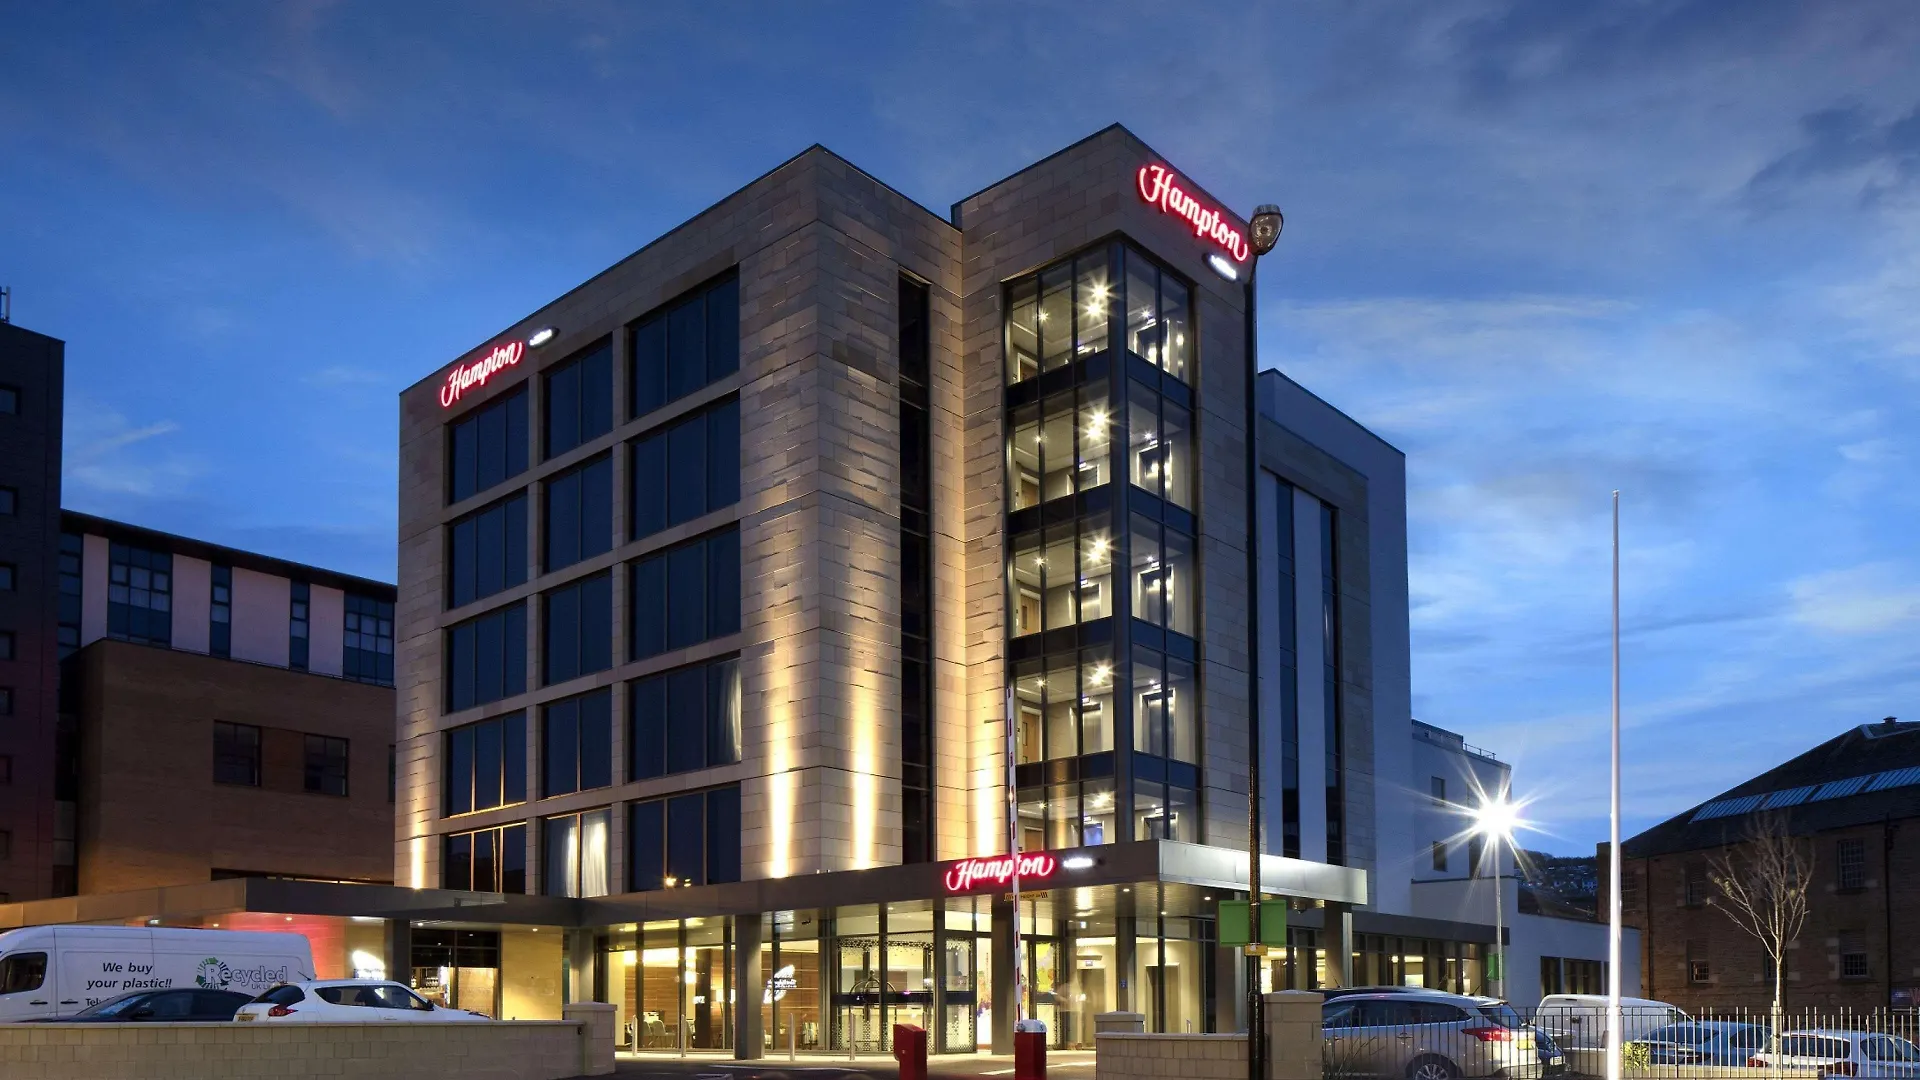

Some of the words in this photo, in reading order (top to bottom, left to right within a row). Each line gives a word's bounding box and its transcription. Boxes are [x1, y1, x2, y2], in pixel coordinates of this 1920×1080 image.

[1138, 165, 1248, 261] Hampton
[441, 341, 523, 407] Hampton
[945, 854, 1054, 891] Hampton
[103, 962, 123, 973] We
[128, 962, 153, 975] buy
[204, 963, 288, 989] Recycled
[86, 979, 118, 991] your
[122, 978, 172, 990] plastic!!
